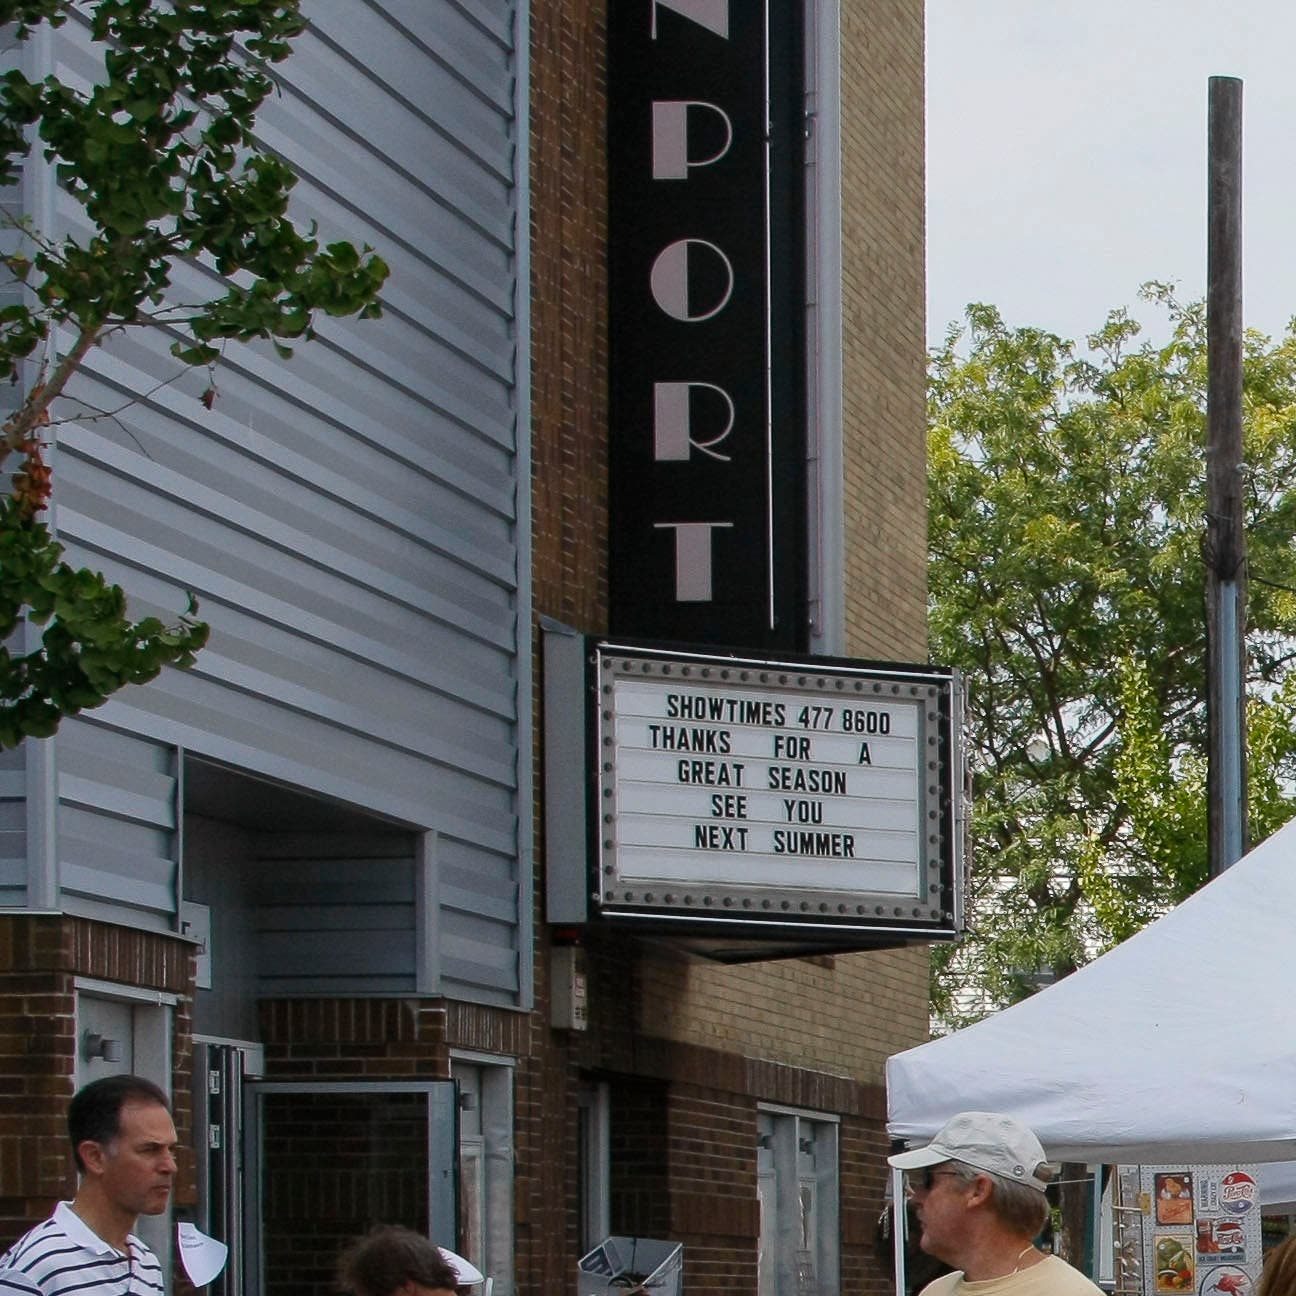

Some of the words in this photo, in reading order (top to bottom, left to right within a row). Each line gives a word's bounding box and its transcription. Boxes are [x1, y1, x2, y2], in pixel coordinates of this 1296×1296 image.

[667, 694, 785, 726] SHOWTIMES
[799, 706, 833, 729] 477
[843, 709, 890, 734] 8600
[649, 725, 731, 754] THANKS
[774, 735, 811, 760] FOR
[858, 742, 871, 764] A
[678, 759, 745, 787] GREAT
[768, 767, 846, 794] SEASON
[711, 794, 747, 819] SEE
[783, 799, 823, 824] YOU
[695, 825, 748, 850] NEXT
[774, 830, 855, 858] SUMMER
